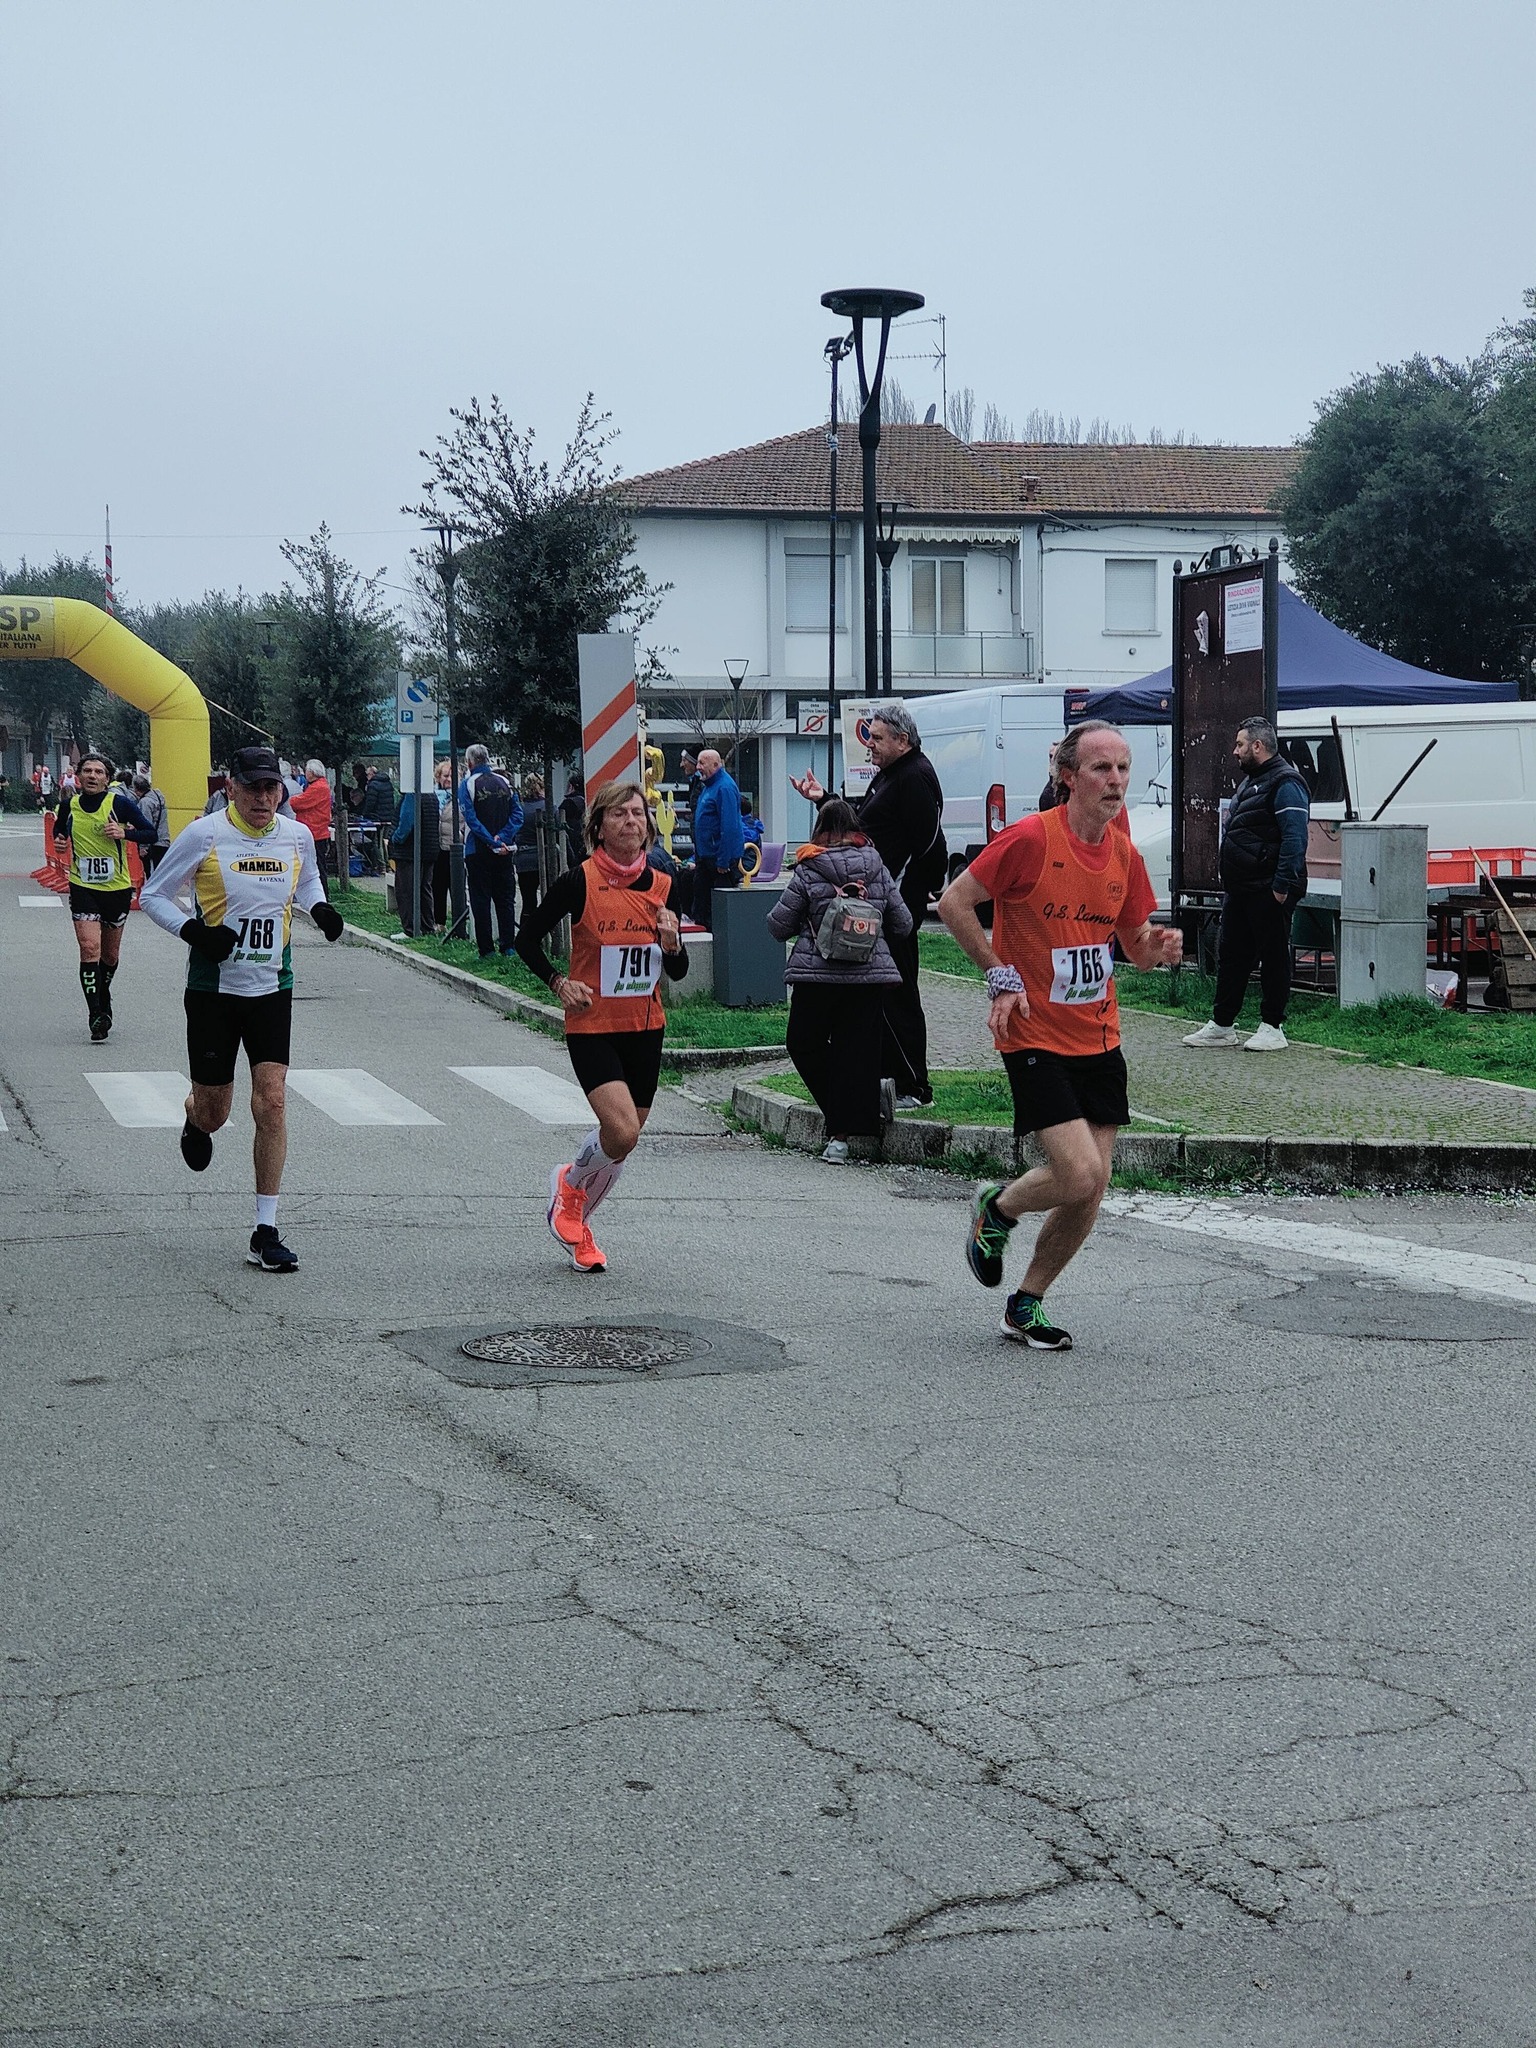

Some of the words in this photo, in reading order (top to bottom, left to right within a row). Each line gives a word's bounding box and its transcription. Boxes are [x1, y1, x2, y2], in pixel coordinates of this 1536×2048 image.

[87, 858, 108, 874] 785
[238, 861, 282, 872] MAMELI
[238, 917, 275, 950] 768
[619, 946, 651, 979] 791
[1067, 948, 1104, 985] 766
